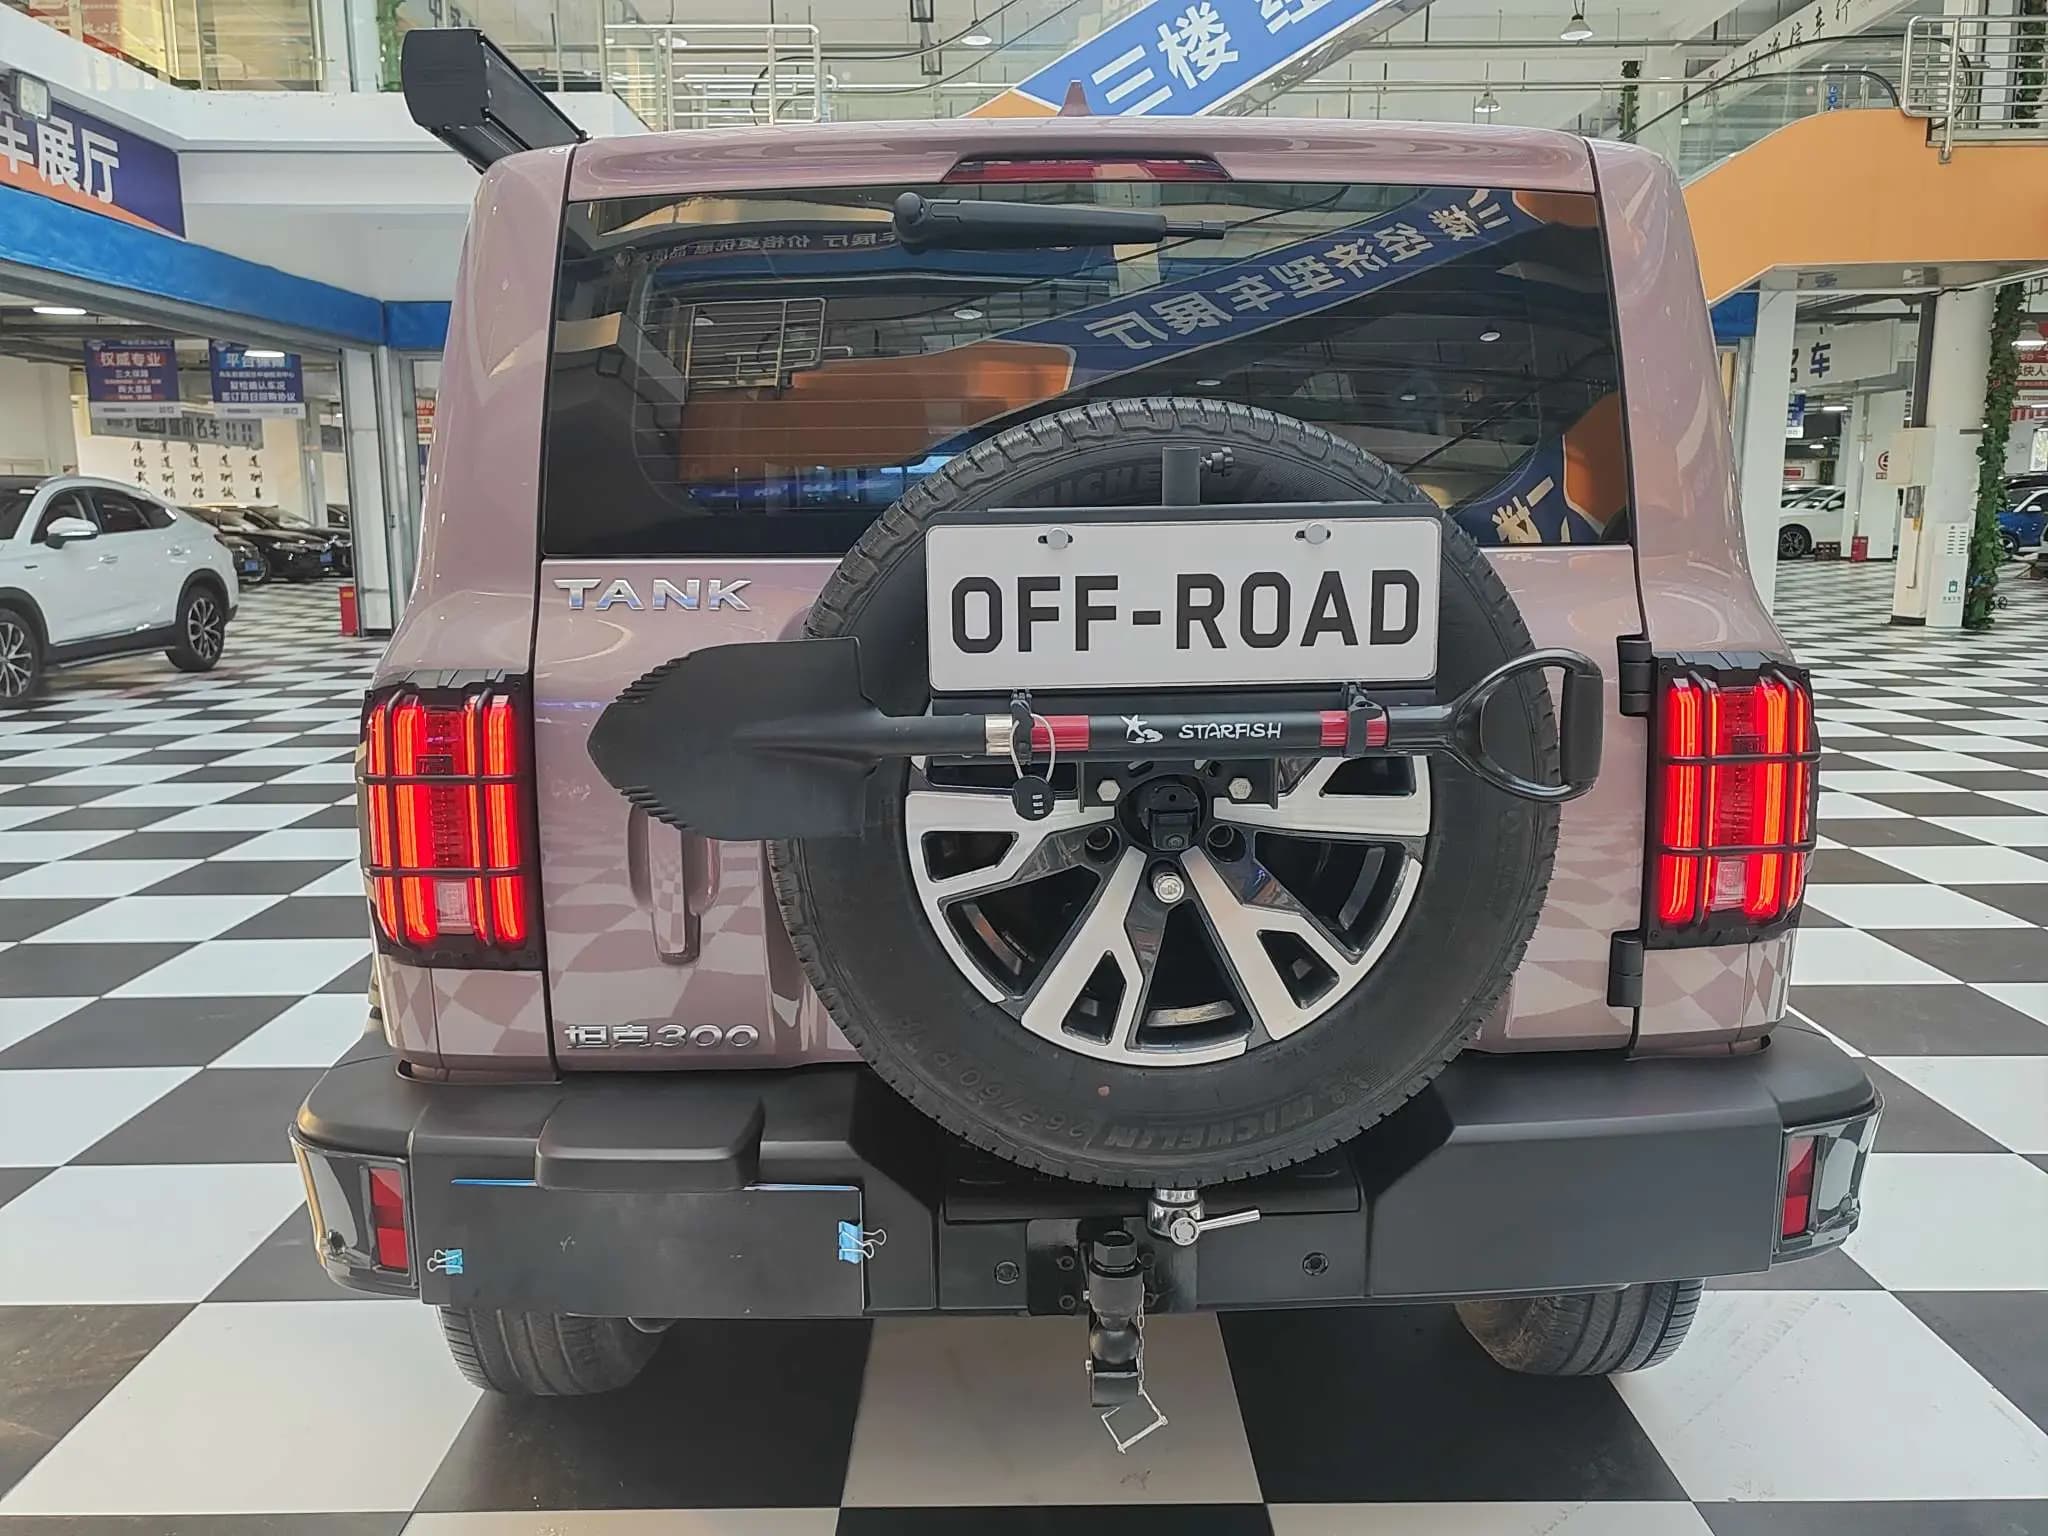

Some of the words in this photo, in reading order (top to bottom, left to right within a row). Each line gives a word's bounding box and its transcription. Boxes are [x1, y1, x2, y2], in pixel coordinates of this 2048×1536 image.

[1091, 2, 1240, 116] 三楼
[100, 351, 161, 367] 权威专业
[553, 577, 752, 612] TANK
[951, 569, 1420, 654] OFF-ROAD
[1177, 721, 1284, 741] STARFISH
[564, 1023, 760, 1050] 坦克300
[1104, 1093, 1316, 1150] MICHELIN
